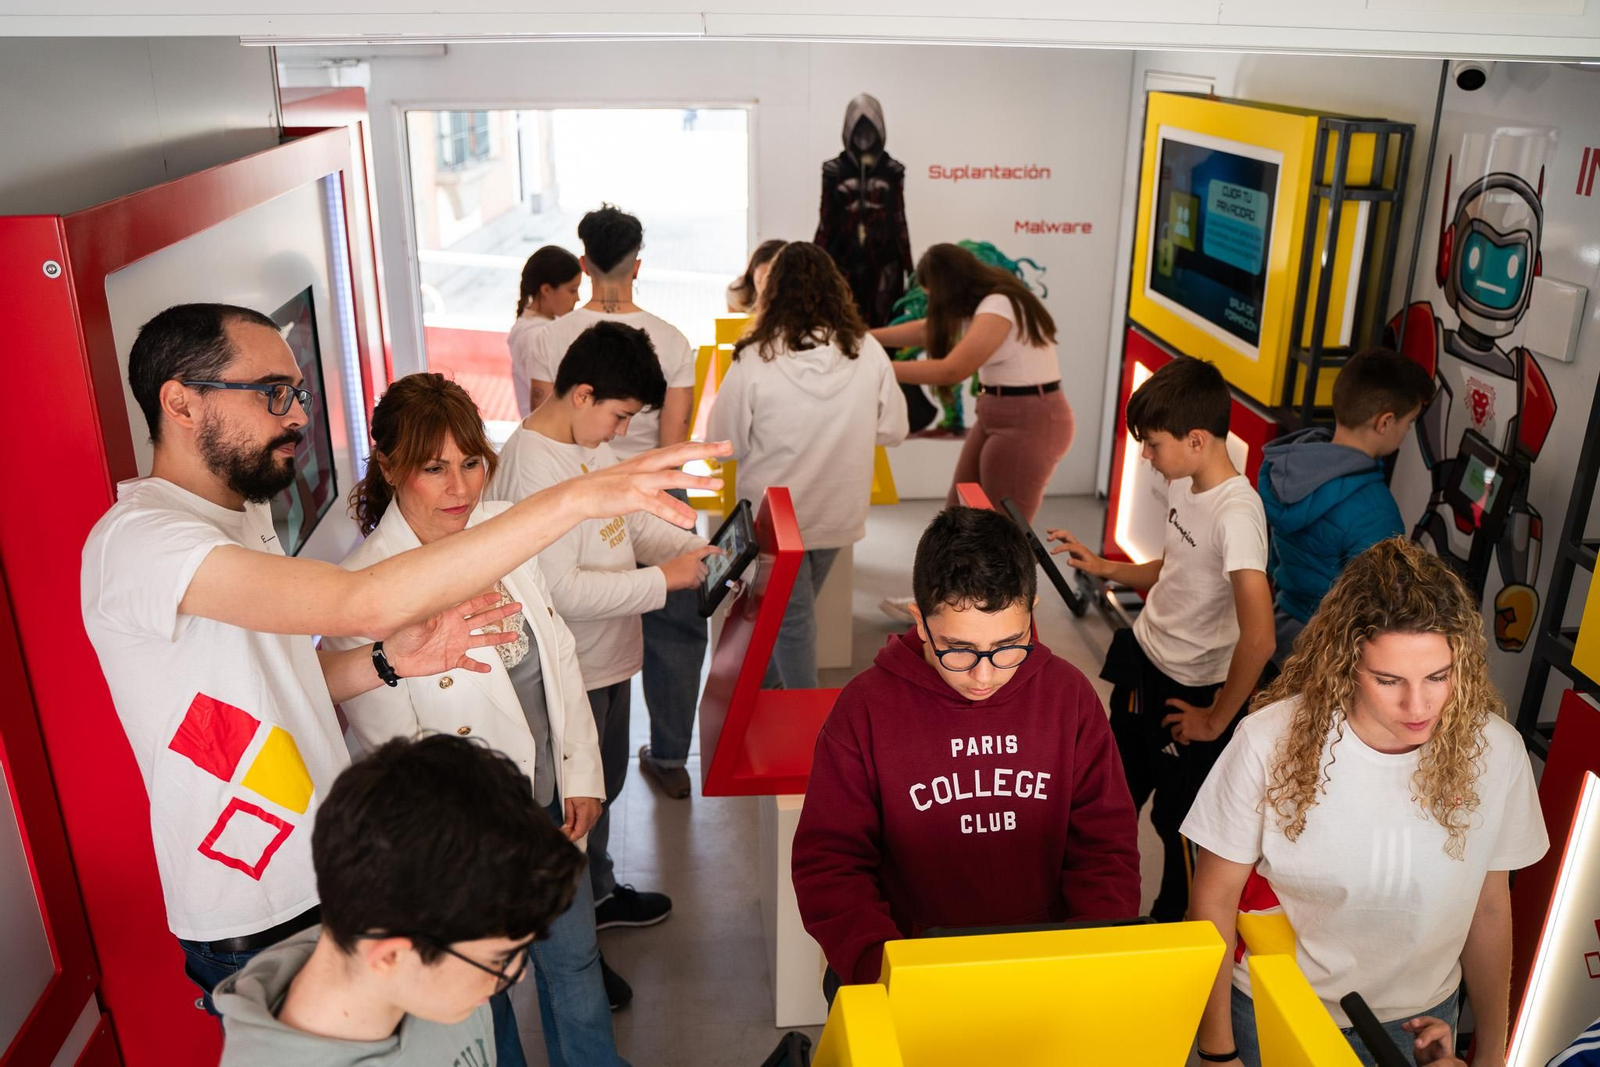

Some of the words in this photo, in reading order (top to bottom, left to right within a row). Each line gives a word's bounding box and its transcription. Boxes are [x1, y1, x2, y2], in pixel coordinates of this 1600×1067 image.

[928, 164, 1051, 182] Suplantación
[1014, 220, 1092, 234] Malware
[950, 734, 1018, 758] PARIS
[909, 768, 1051, 811] COLLEGE
[960, 810, 1017, 834] CLUB
